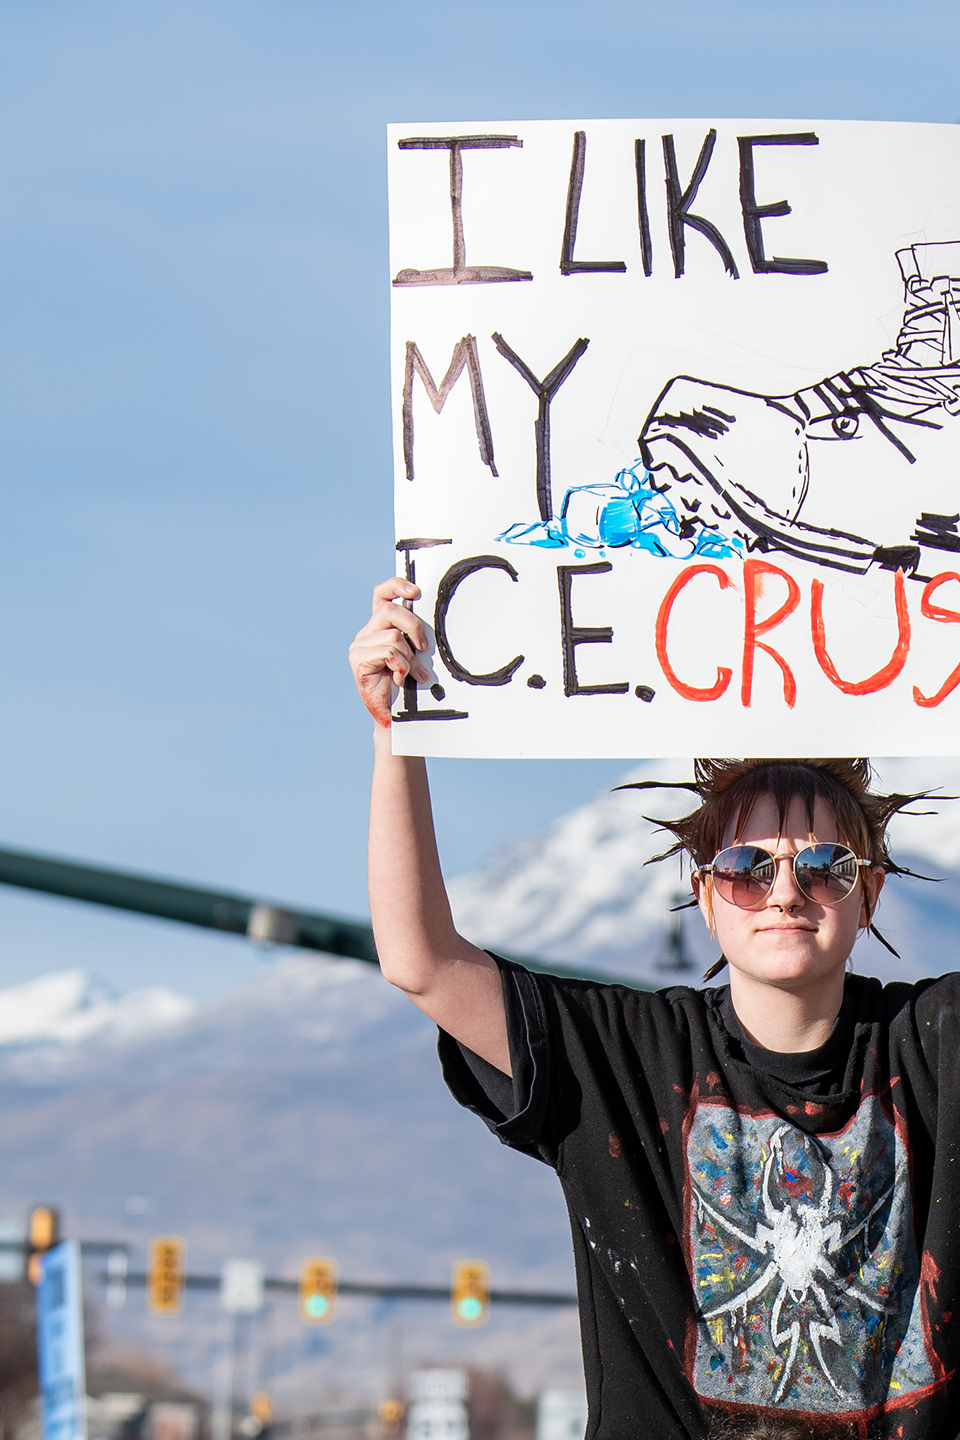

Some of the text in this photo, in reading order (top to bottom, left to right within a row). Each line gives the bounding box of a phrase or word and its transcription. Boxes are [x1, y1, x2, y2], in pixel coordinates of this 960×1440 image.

[393, 128, 829, 288] I LIKE
[403, 332, 590, 522] MY
[392, 538, 656, 723] I.C.E.
